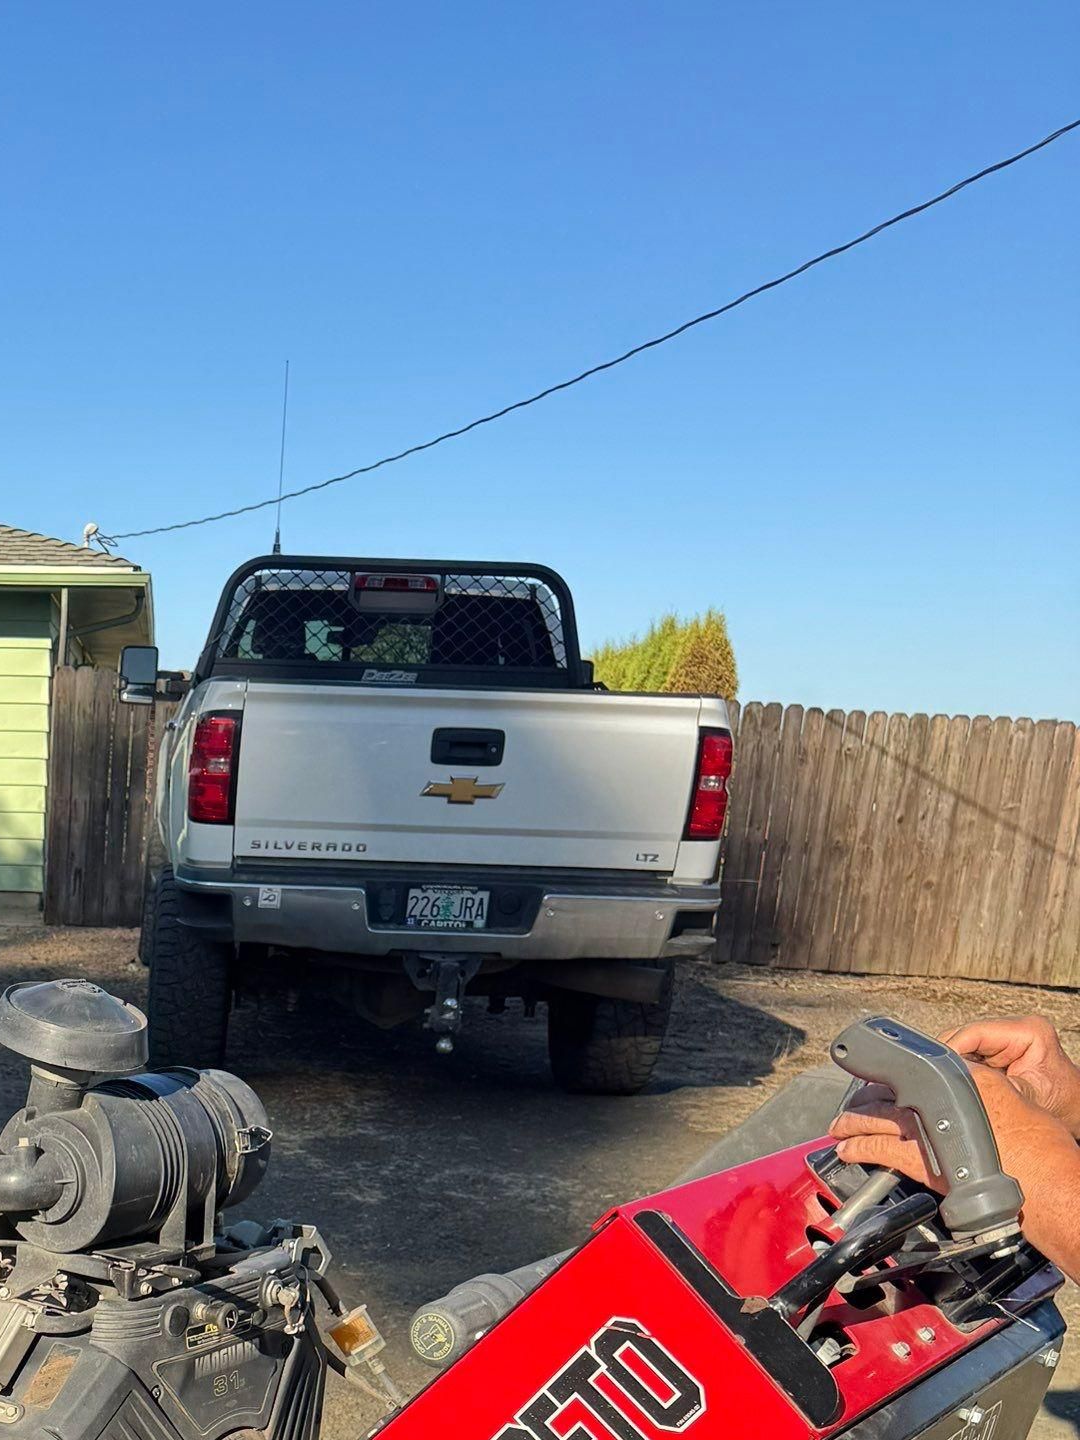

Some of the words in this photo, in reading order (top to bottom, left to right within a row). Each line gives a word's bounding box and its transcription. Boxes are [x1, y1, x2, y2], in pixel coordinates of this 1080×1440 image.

[249, 839, 368, 853] SILVERADO
[635, 852, 660, 863] LTZ
[408, 895, 441, 919] 226
[452, 896, 485, 921] JRA
[213, 1369, 240, 1397] 31
